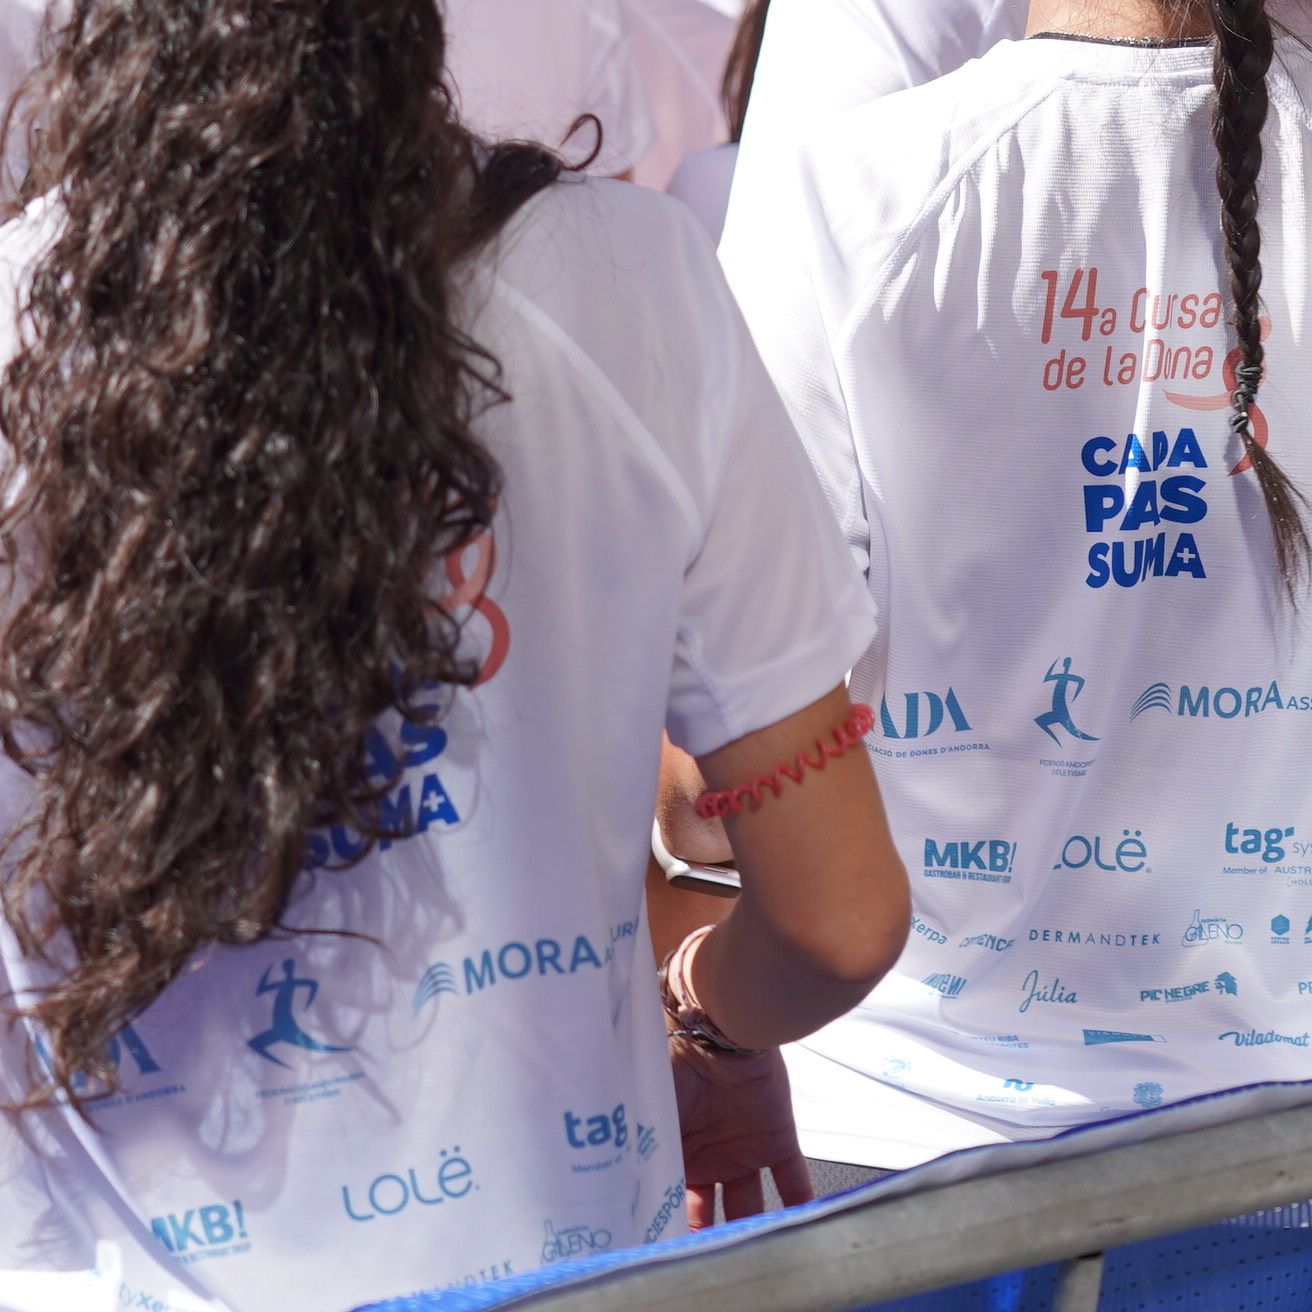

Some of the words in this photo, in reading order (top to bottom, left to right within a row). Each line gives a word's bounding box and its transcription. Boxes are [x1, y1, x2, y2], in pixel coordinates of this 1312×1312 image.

[1042, 348, 1087, 392] de
[1103, 345, 1137, 386] la
[1083, 475, 1208, 532] PAS
[1085, 532, 1207, 588] SUMA
[1178, 680, 1284, 718] MORA
[895, 750, 907, 759] DE
[910, 748, 938, 758] DONES
[940, 743, 991, 754] D'ANDORRA
[924, 838, 1017, 873] MKB!
[1225, 822, 1295, 863] tag
[1223, 867, 1256, 875] Member
[1258, 866, 1267, 874] of
[1029, 928, 1161, 946] DERMANDTEK
[464, 935, 602, 994] MORA
[1019, 970, 1078, 1013] Júlia
[1218, 1029, 1310, 1047] Viladomat
[564, 1103, 628, 1148] tag
